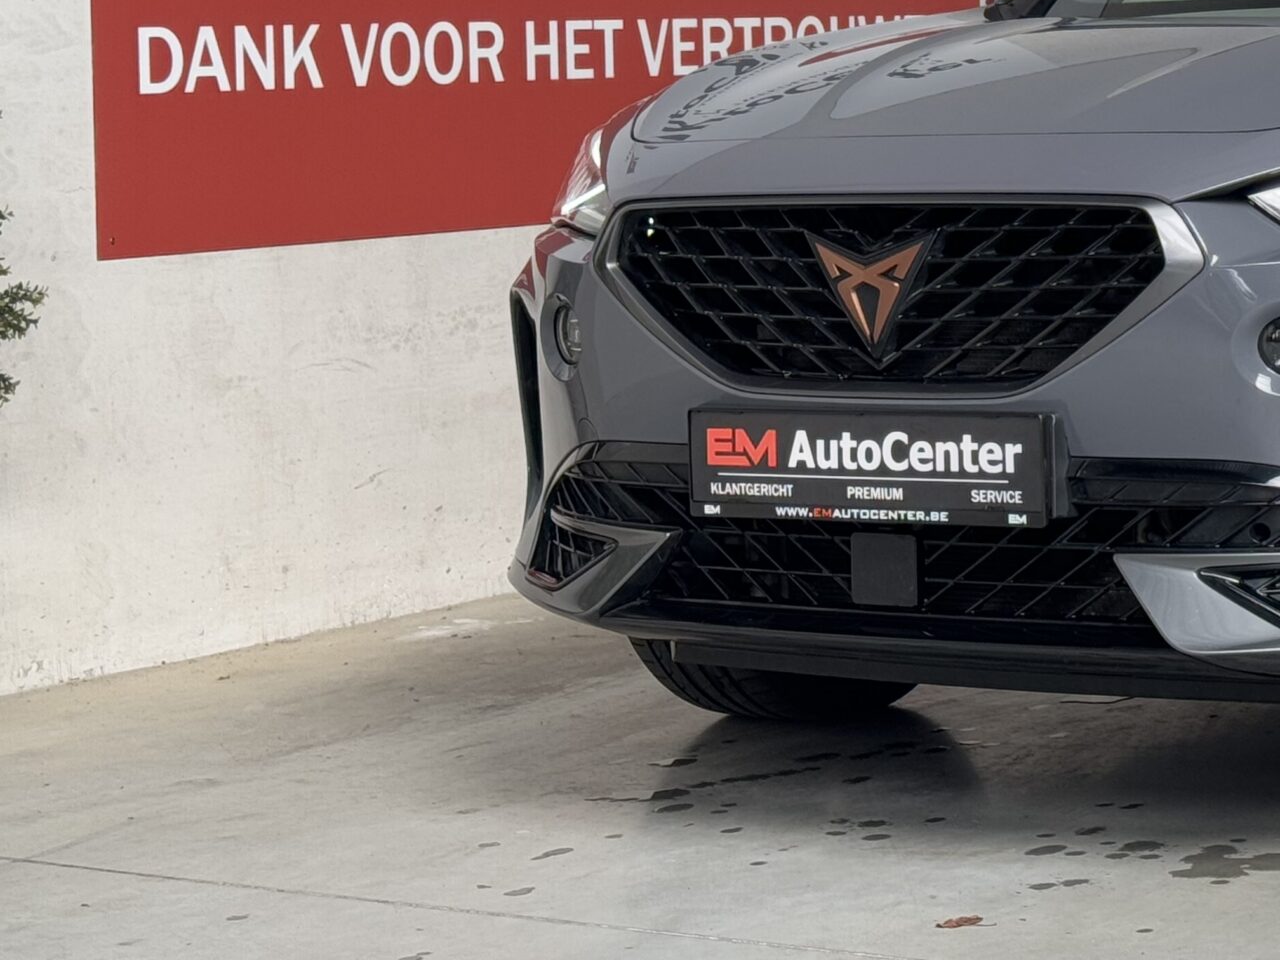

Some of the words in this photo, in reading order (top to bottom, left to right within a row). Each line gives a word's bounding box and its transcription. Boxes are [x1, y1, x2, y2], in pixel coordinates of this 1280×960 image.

[137, 24, 324, 95] DANK
[340, 21, 505, 87] VOOR
[525, 19, 624, 81] HET
[706, 428, 777, 467] EM
[787, 429, 1023, 474] AutoCenter
[710, 482, 794, 497] KLANTGERICHT
[846, 486, 904, 501] PREMIUM
[970, 489, 1023, 504] SERVICE
[775, 506, 949, 522] WWW.EMAUTOCENTER.BE
